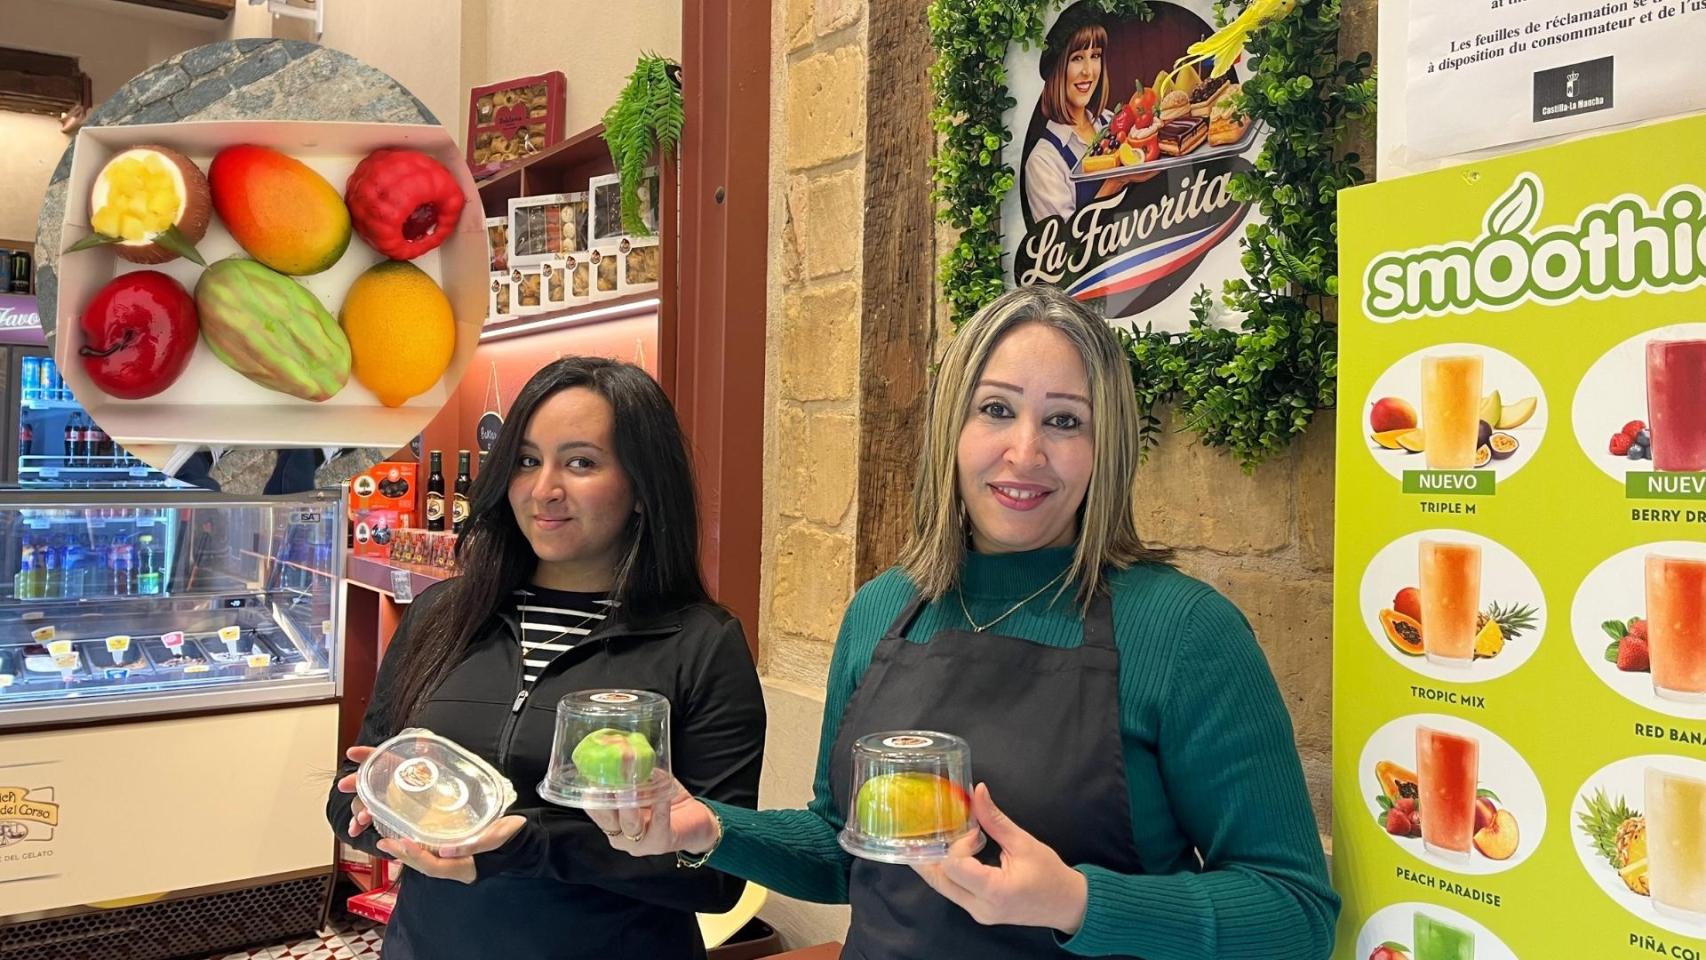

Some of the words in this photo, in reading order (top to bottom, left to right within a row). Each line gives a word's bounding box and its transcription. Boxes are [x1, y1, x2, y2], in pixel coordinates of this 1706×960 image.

[1450, 40, 1471, 53] Les
[1475, 27, 1520, 46] feuilles
[1525, 22, 1541, 35] de
[1545, 2, 1628, 31] réclamation
[1427, 62, 1435, 73] à
[1438, 48, 1504, 71] disposition
[1509, 41, 1527, 54] du
[1531, 16, 1636, 49] consommateur
[1639, 11, 1652, 23] et
[1658, 5, 1676, 19] de
[1577, 96, 1604, 109] Mancha
[1020, 218, 1069, 287] La
[1066, 168, 1235, 273] Favorita
[1419, 474, 1478, 490] NUEVO
[1420, 501, 1462, 514] TRIPLE
[1465, 503, 1476, 515] M
[1631, 508, 1681, 522] BERRY
[1411, 686, 1457, 704] TROPIC
[1461, 694, 1485, 709] MIX
[1635, 723, 1665, 738] RED
[19, 803, 51, 819] Corso
[22, 849, 54, 860] GELATO
[1396, 866, 1435, 888] PEACH
[1439, 879, 1501, 907] PARADISE
[1629, 933, 1667, 956] PIÑA
